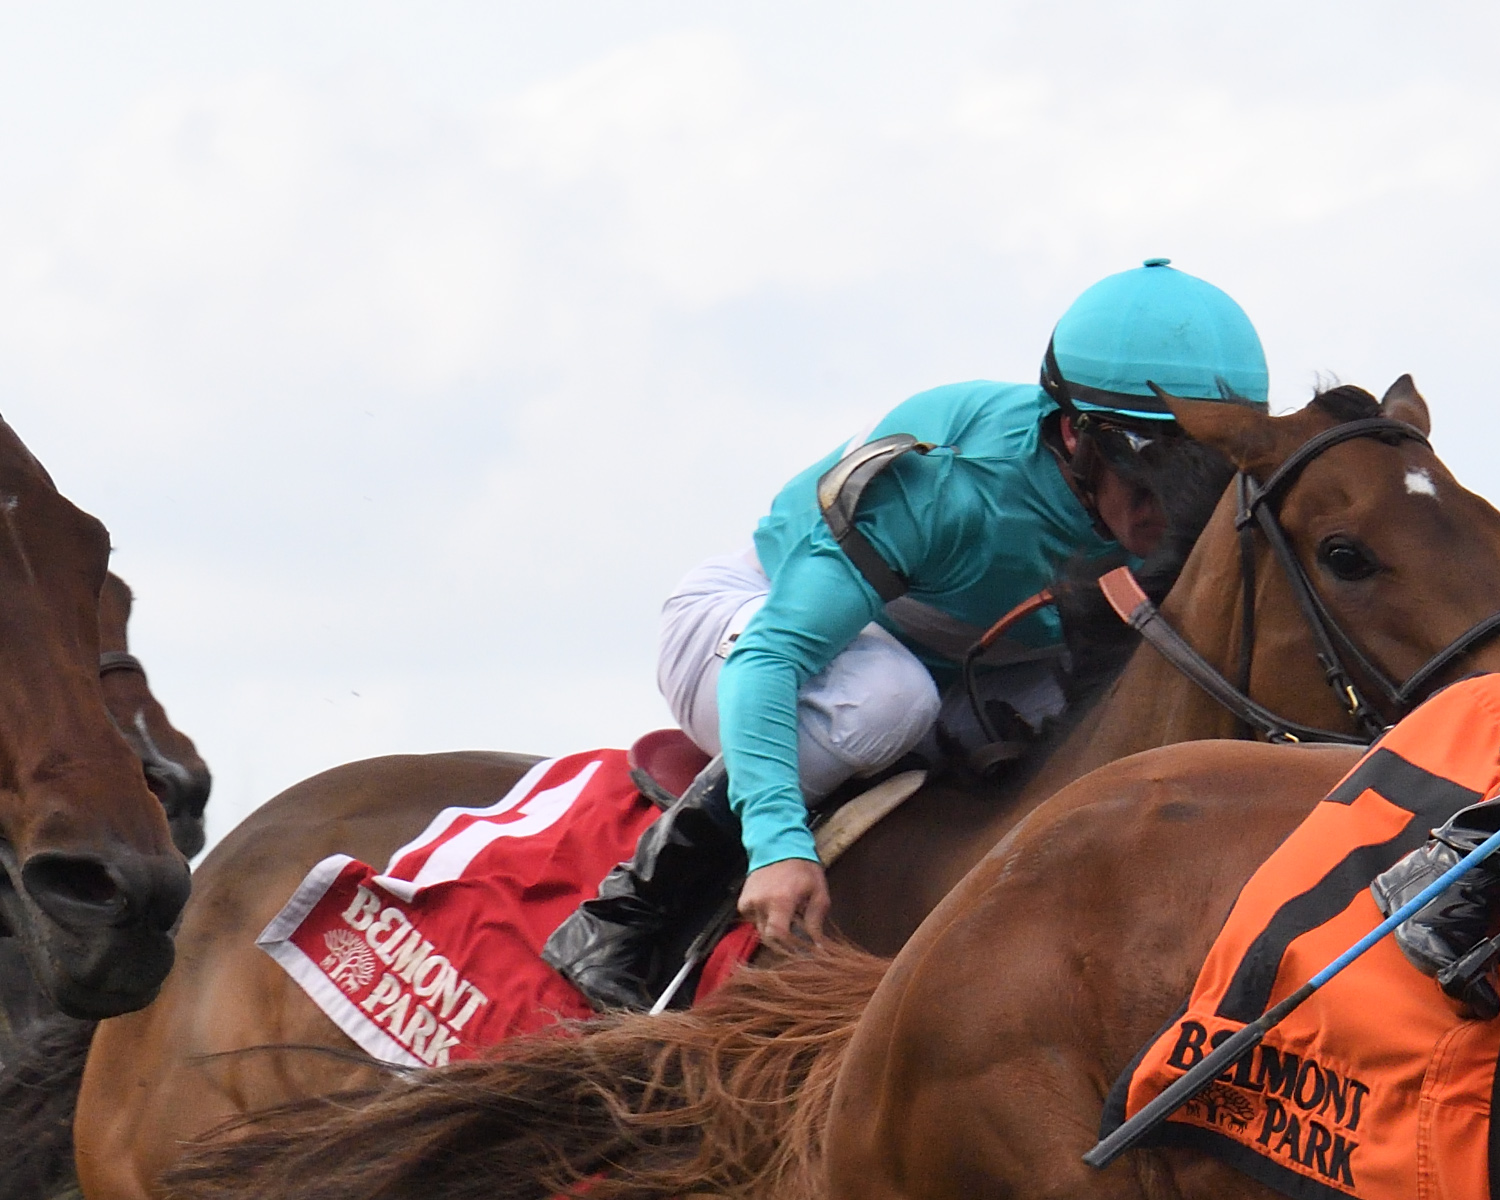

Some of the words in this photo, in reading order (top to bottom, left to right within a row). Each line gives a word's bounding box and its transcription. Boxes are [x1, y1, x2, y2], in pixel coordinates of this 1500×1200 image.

[412, 761, 603, 886] 1
[1216, 749, 1485, 1020] 7
[341, 885, 488, 1031] BELMONT
[360, 973, 460, 1067] PARK
[1255, 1098, 1359, 1187] PARK
